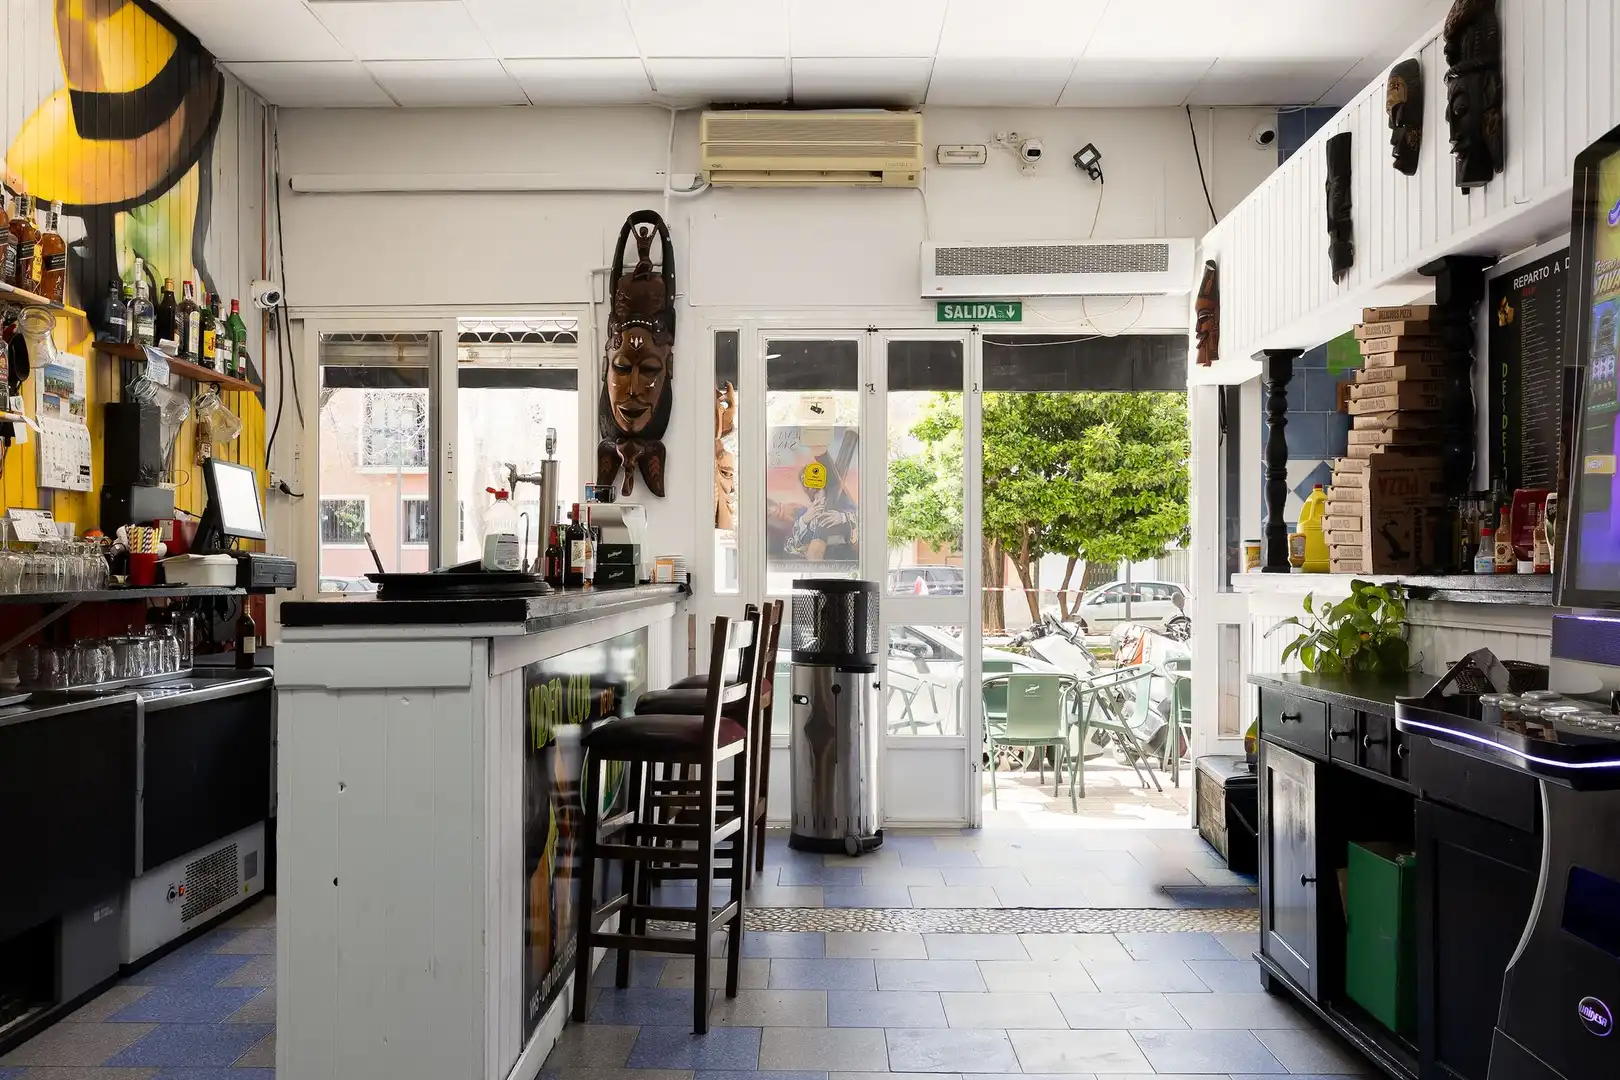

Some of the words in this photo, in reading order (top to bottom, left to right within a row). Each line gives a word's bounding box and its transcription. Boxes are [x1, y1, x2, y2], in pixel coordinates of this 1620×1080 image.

[1513, 265, 1550, 290] REPARTO
[1553, 261, 1561, 274] A
[944, 305, 997, 319] SALIDA
[1400, 308, 1412, 319] PIZZA
[529, 677, 563, 754] VIDEO
